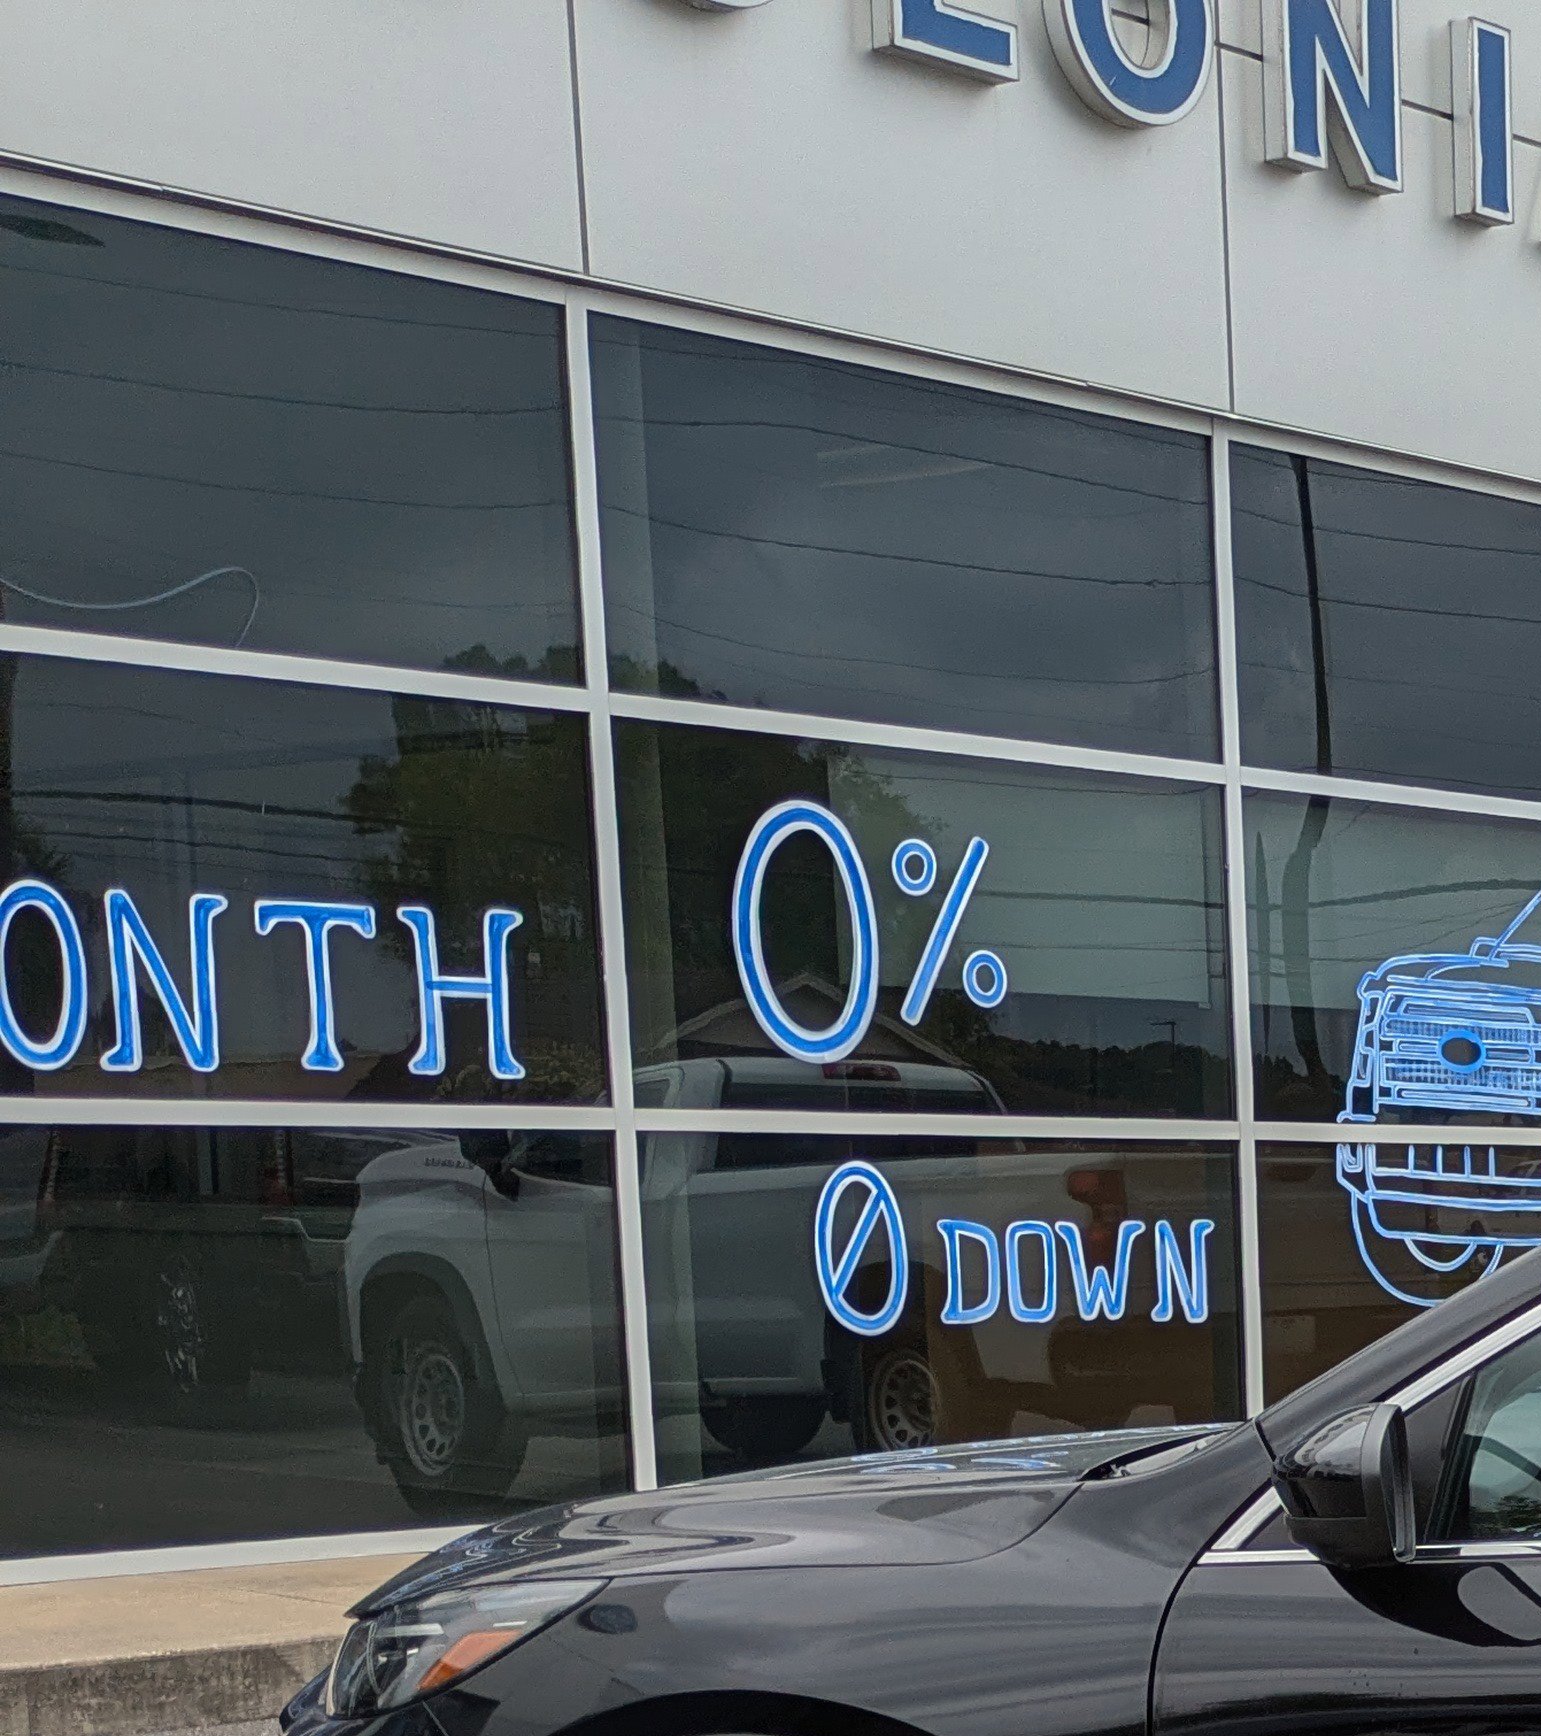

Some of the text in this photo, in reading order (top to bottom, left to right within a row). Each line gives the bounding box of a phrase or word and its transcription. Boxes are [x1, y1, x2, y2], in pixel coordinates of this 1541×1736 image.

[0, 878, 526, 1081] ONTH
[732, 800, 1008, 1063] 0%
[936, 1218, 1215, 1325] DOWN
